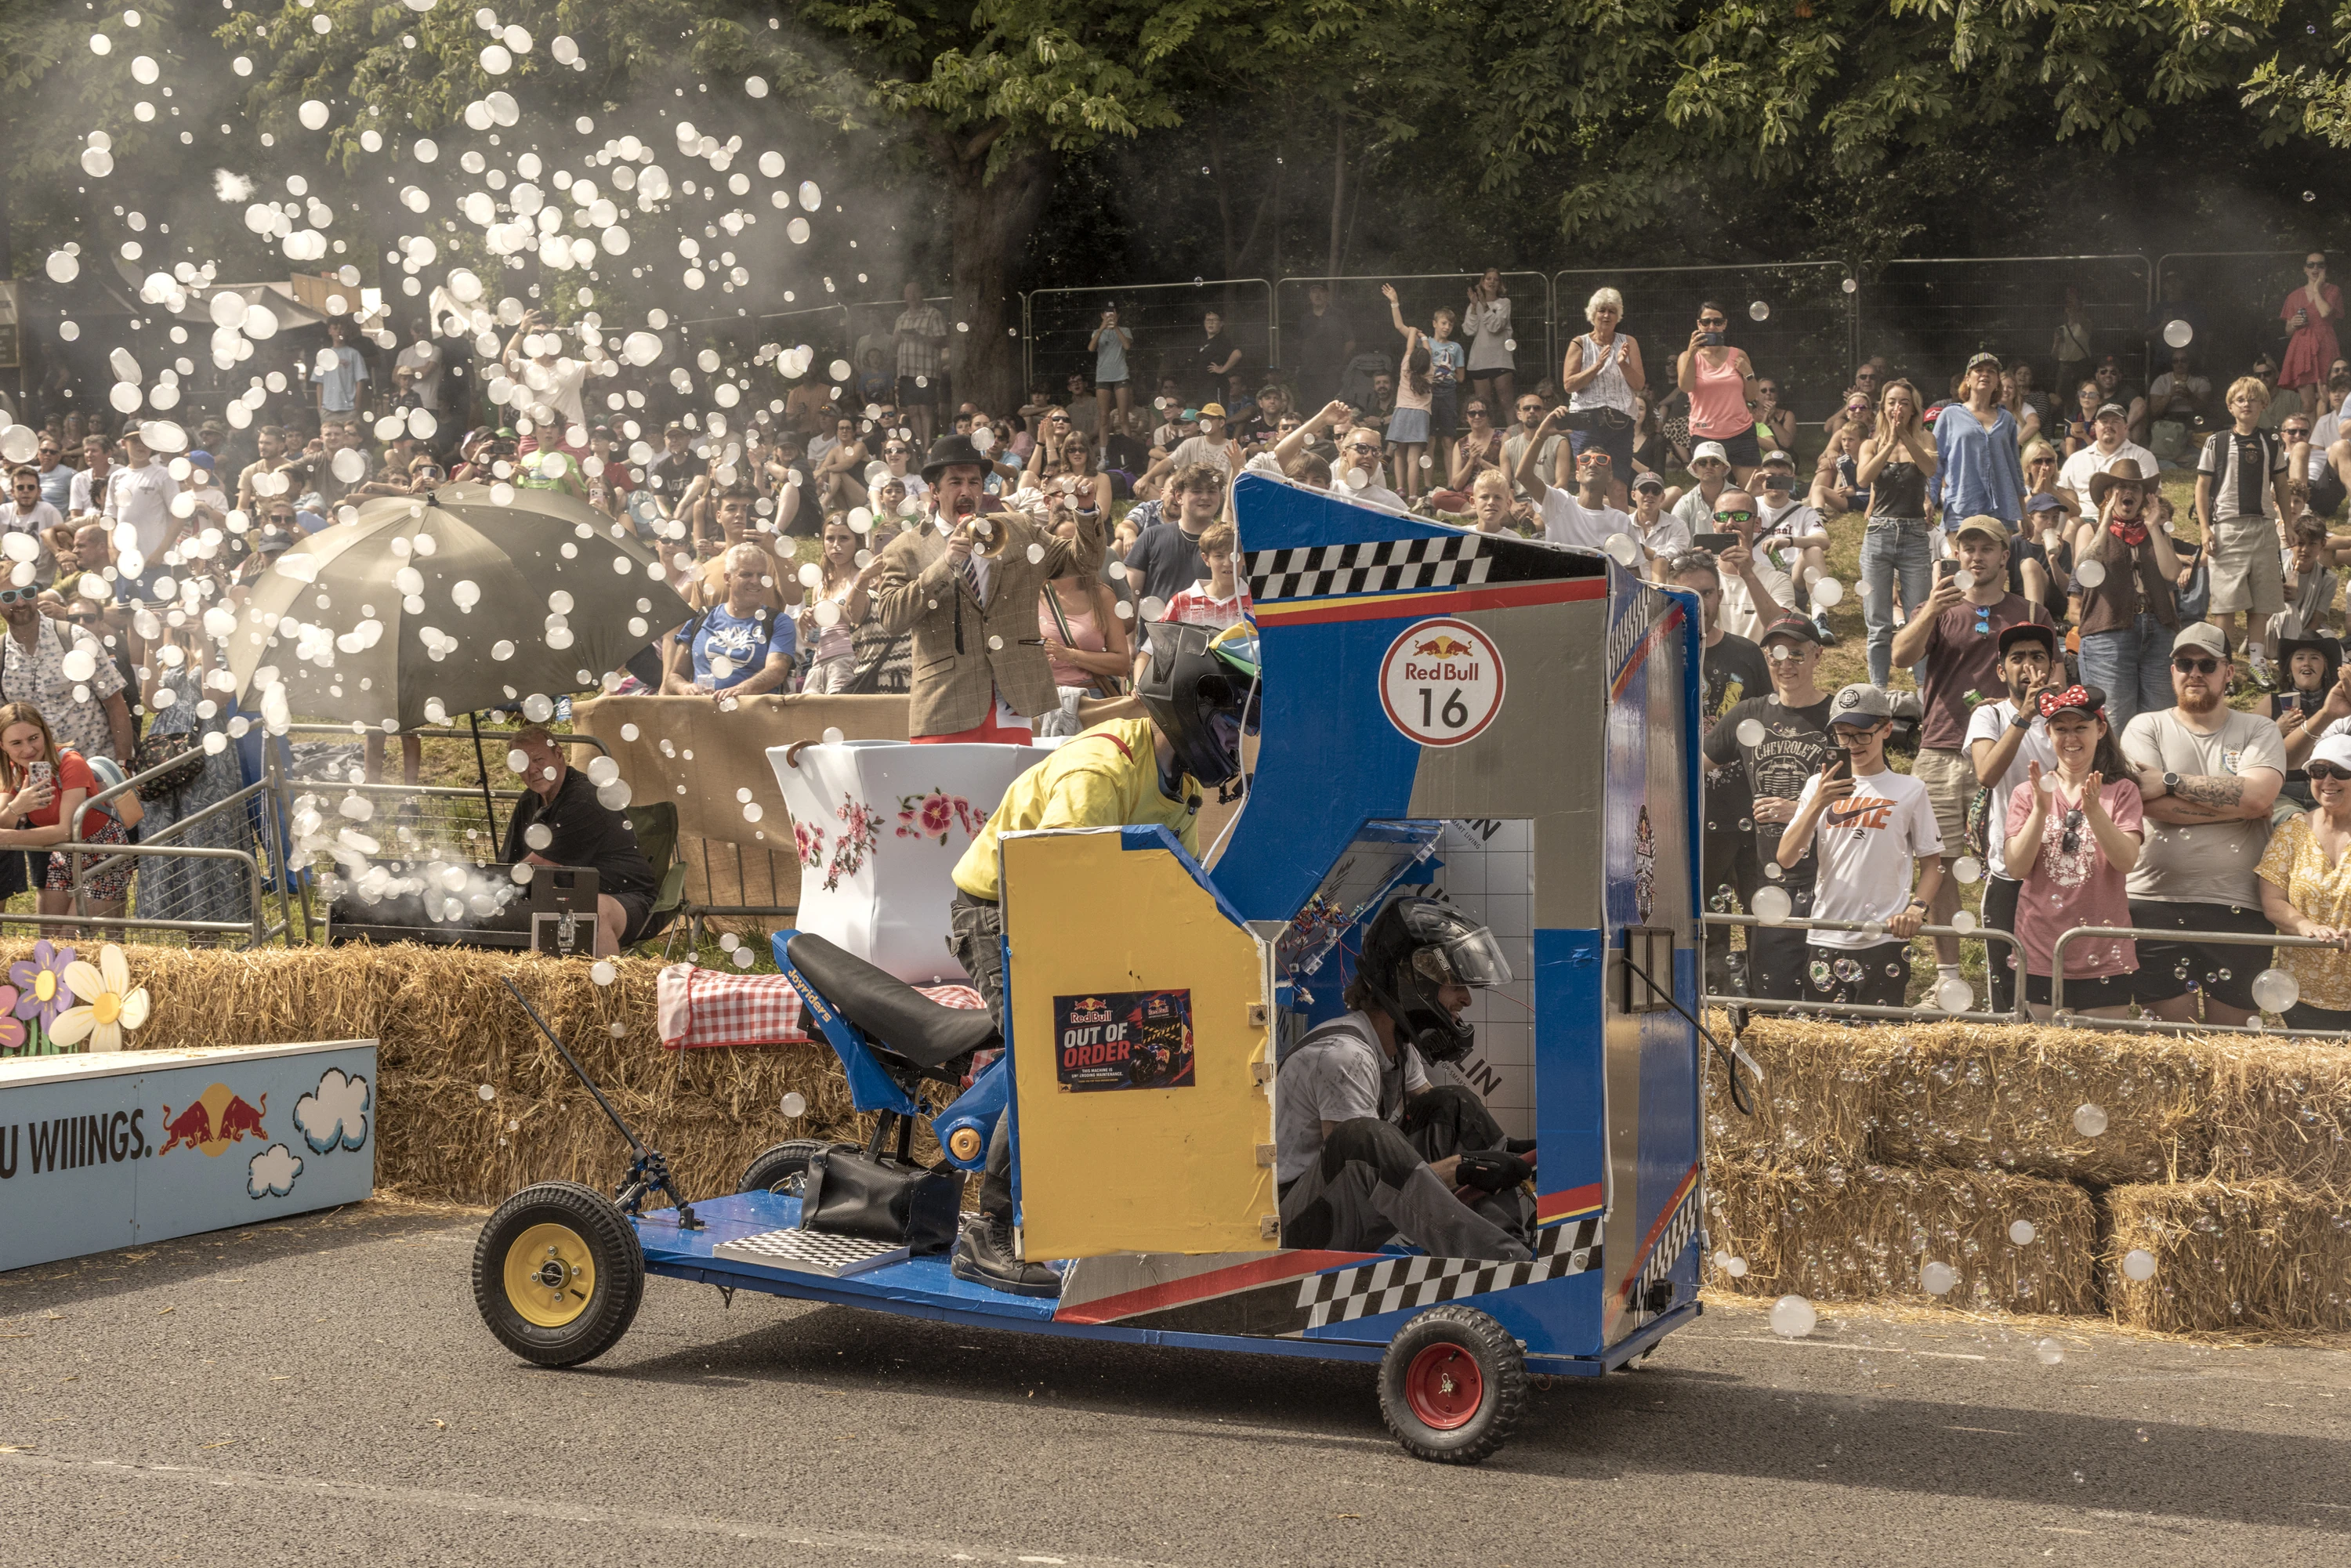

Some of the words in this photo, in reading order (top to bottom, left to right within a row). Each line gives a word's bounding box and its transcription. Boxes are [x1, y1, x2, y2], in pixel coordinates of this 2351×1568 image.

[1405, 662, 1440, 680] Red
[1444, 663, 1479, 681] Bull
[1419, 687, 1469, 729] 16
[1755, 740, 1823, 762] CHEVROLET
[1450, 820, 1465, 833] MART
[1464, 831, 1481, 850] LIVING
[788, 969, 831, 1023] Joyriders
[1070, 1012, 1091, 1023] Red
[1092, 1010, 1111, 1022] Bull
[1064, 1027, 1101, 1048] OUT
[1106, 1023, 1128, 1042] OF
[1063, 1041, 1131, 1067] ORDER
[28, 1108, 153, 1175] WIIINGS.
